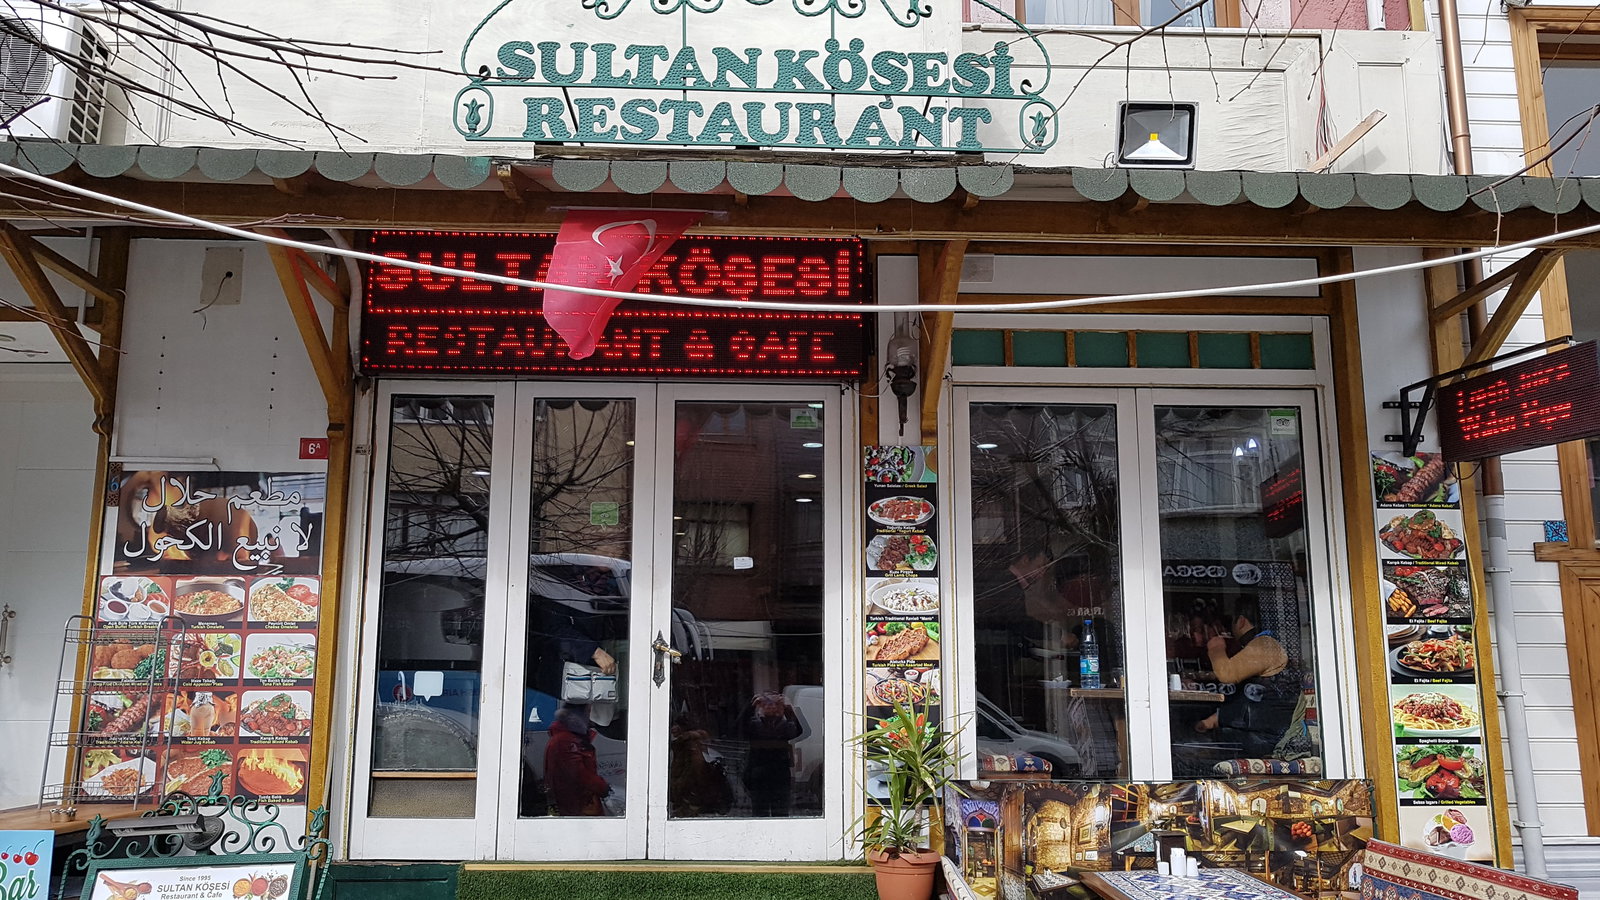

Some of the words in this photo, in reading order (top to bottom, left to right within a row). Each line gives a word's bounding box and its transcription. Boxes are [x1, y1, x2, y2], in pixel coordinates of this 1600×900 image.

[497, 40, 763, 89] SULTAN
[523, 97, 991, 150] RESTAURANT
[1520, 400, 1573, 431] Pipe
[142, 475, 217, 512] حلال
[227, 476, 301, 524] مطعم
[123, 519, 223, 562] الكحول
[291, 522, 313, 550] لا
[157, 884, 197, 893] SULTAN
[160, 892, 199, 900] Restaurant
[207, 891, 223, 899] Cafe
